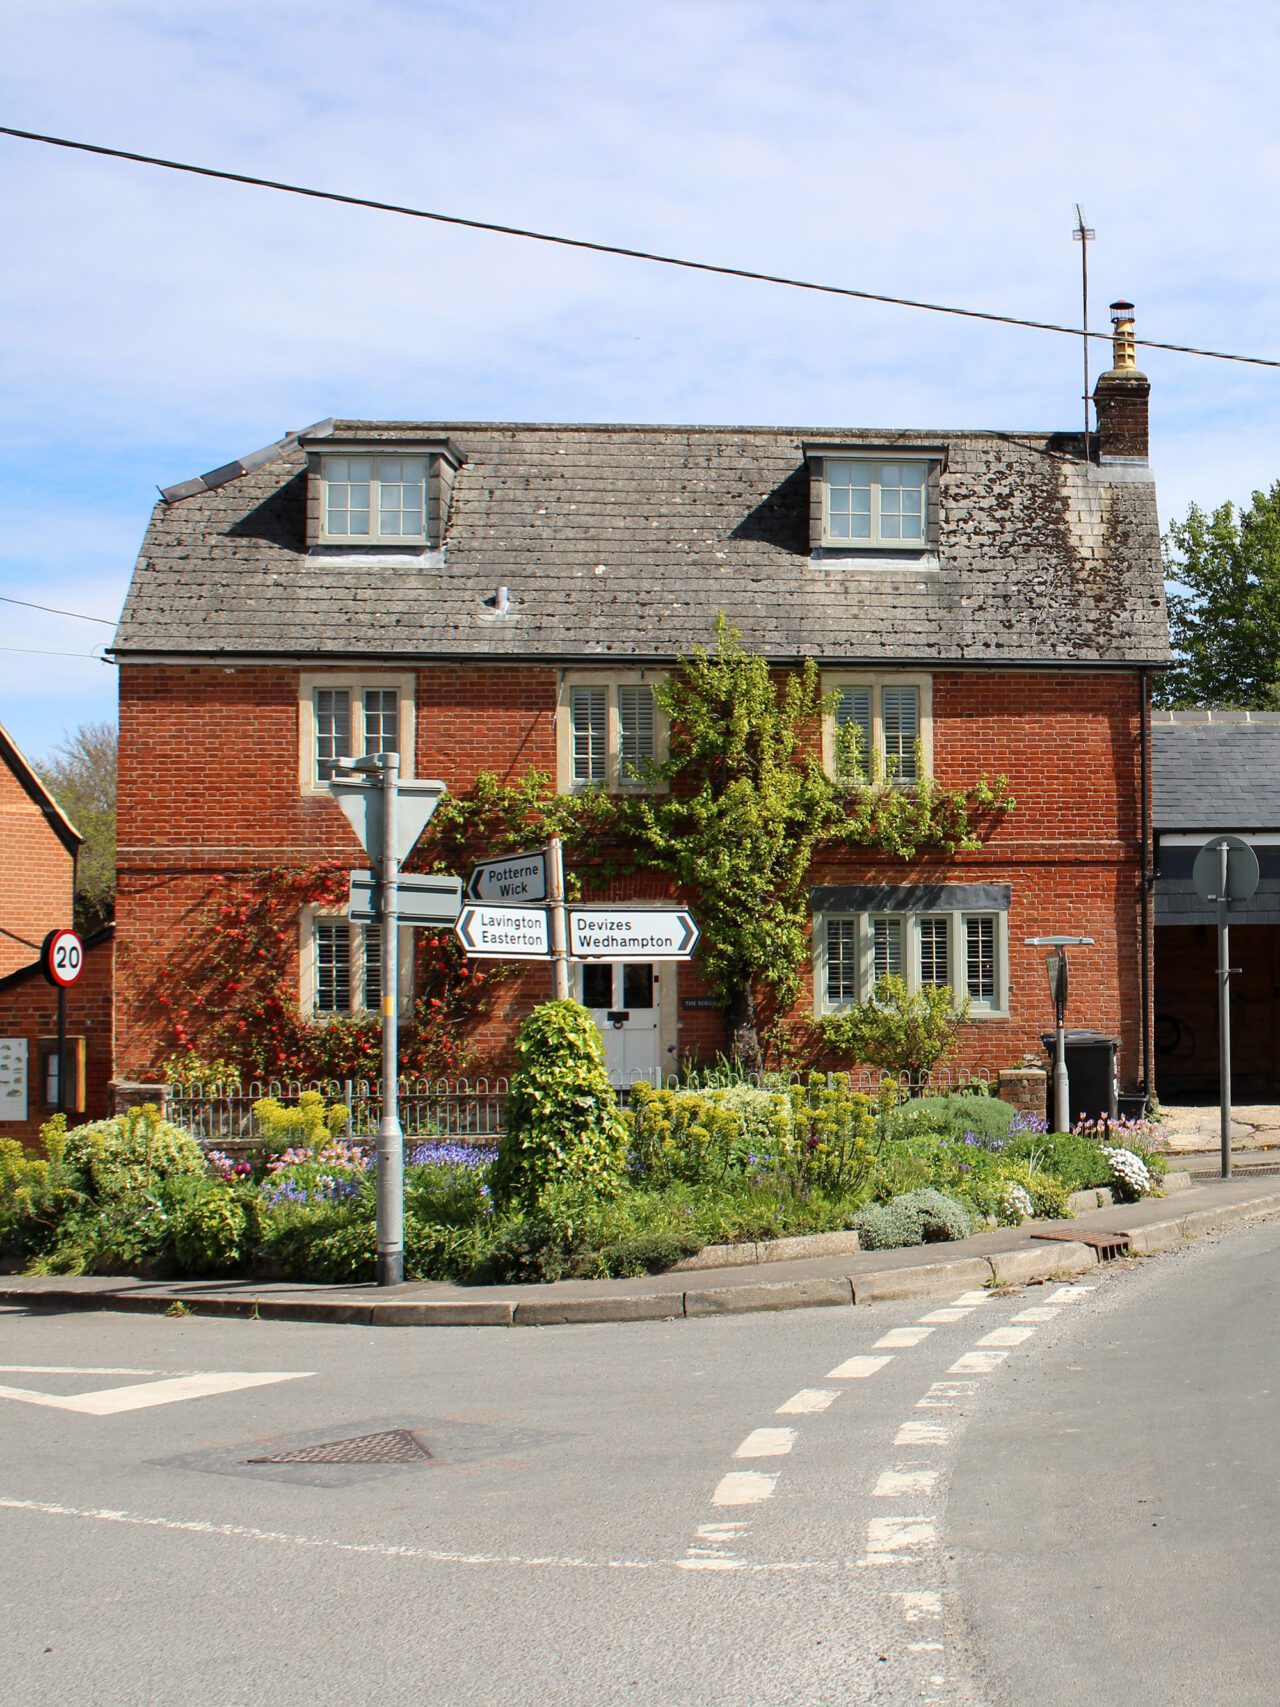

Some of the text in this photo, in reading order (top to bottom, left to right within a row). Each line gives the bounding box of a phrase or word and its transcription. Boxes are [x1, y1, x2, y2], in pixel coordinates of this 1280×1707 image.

[489, 865, 539, 883] Potterne
[500, 881, 528, 897] Wick
[481, 913, 541, 930] Lavington
[577, 918, 632, 931] Devizes
[482, 931, 542, 946] Easterton
[579, 935, 673, 949] Wedhampton
[56, 946, 80, 969] 20
